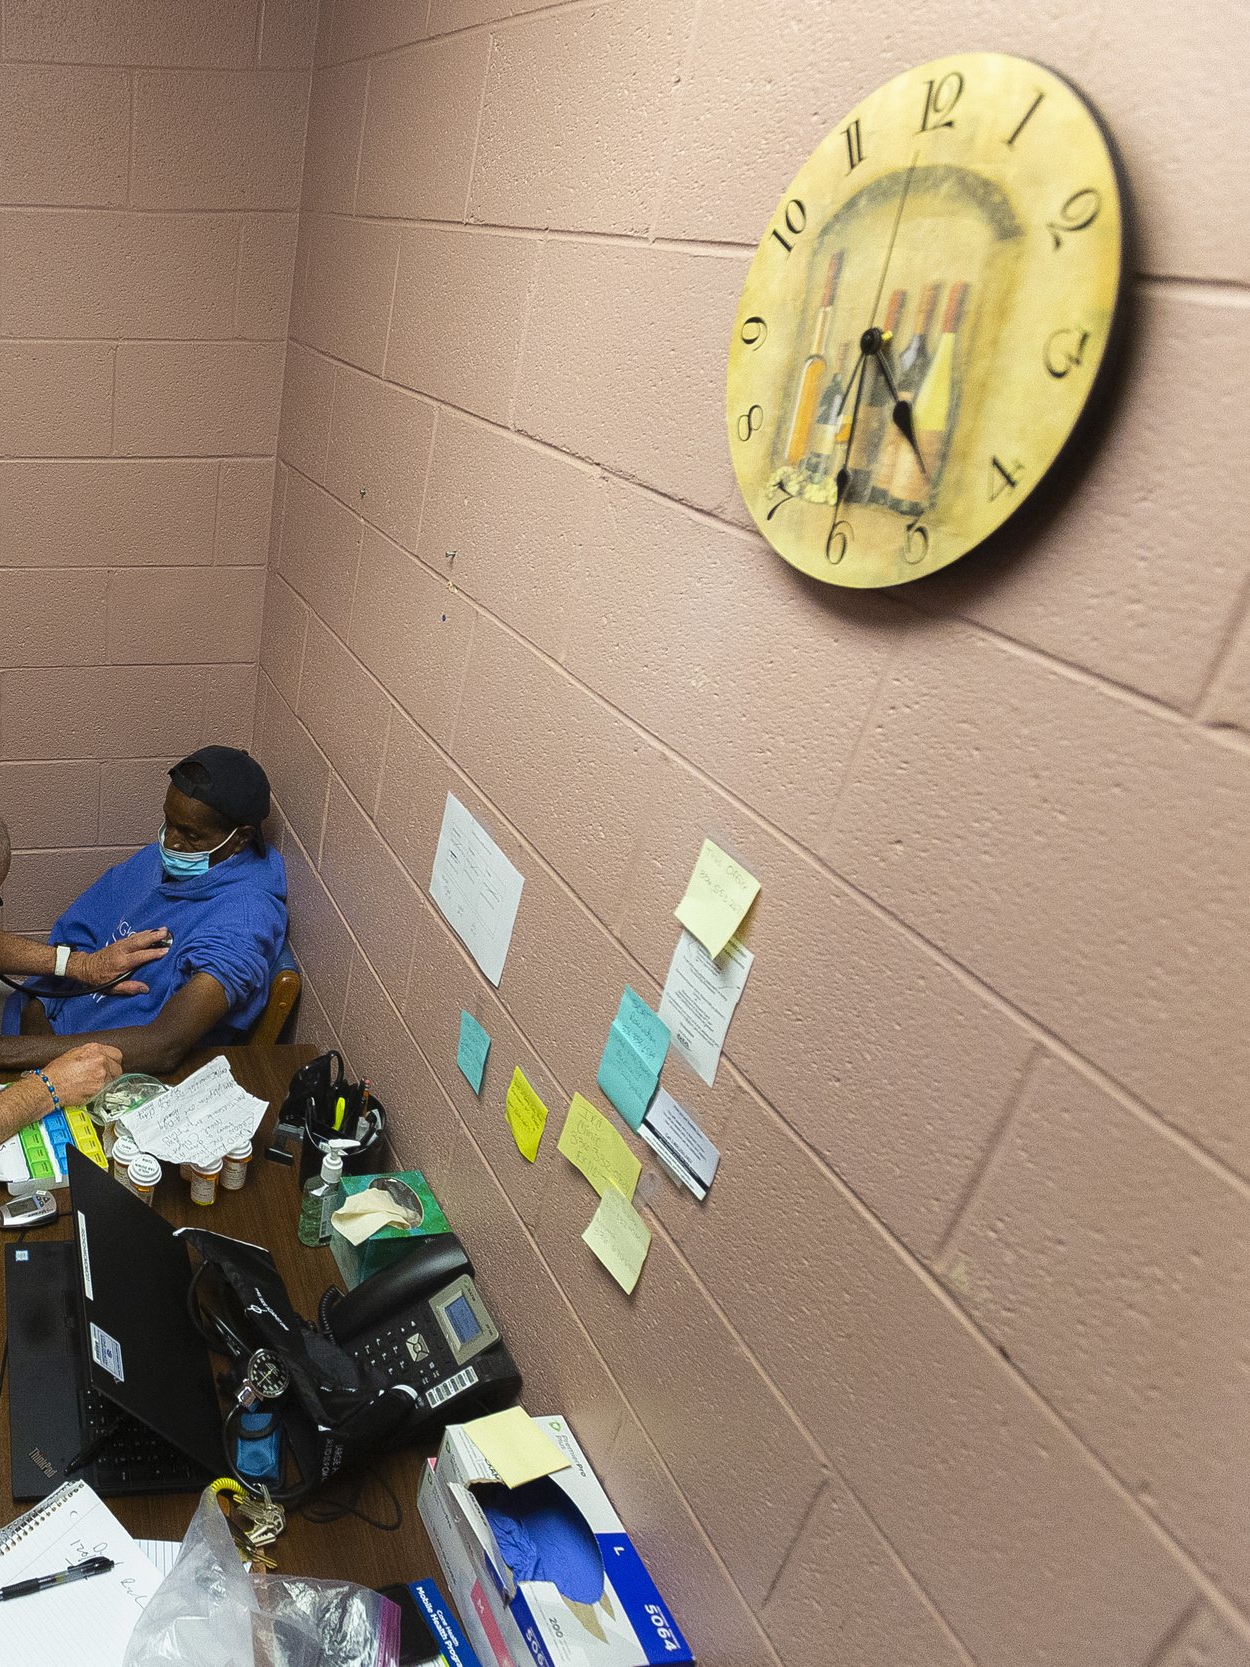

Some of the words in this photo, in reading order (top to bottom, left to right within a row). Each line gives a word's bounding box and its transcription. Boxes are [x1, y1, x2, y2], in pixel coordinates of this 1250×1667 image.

[916, 72, 965, 135] 12
[1006, 90, 1046, 147] 1
[840, 119, 867, 176] 11
[768, 199, 808, 255] 10
[1046, 187, 1102, 251] 2
[741, 316, 768, 352] 9
[1041, 328, 1090, 379] 3
[738, 404, 764, 441] 8
[767, 479, 796, 521] 7
[988, 454, 1026, 502] 4
[825, 519, 856, 565] 6
[901, 517, 930, 565] 5
[28, 1447, 57, 1479] ThinkPad
[555, 1434, 566, 1450] Plus
[562, 1434, 586, 1477] PremierPro
[613, 1546, 625, 1556] L
[416, 1586, 433, 1614] Mobile
[430, 1613, 448, 1642] Health
[436, 1609, 450, 1624] Cone
[444, 1623, 459, 1647] Health
[549, 1616, 563, 1639] 200
[644, 1603, 680, 1652] 5064
